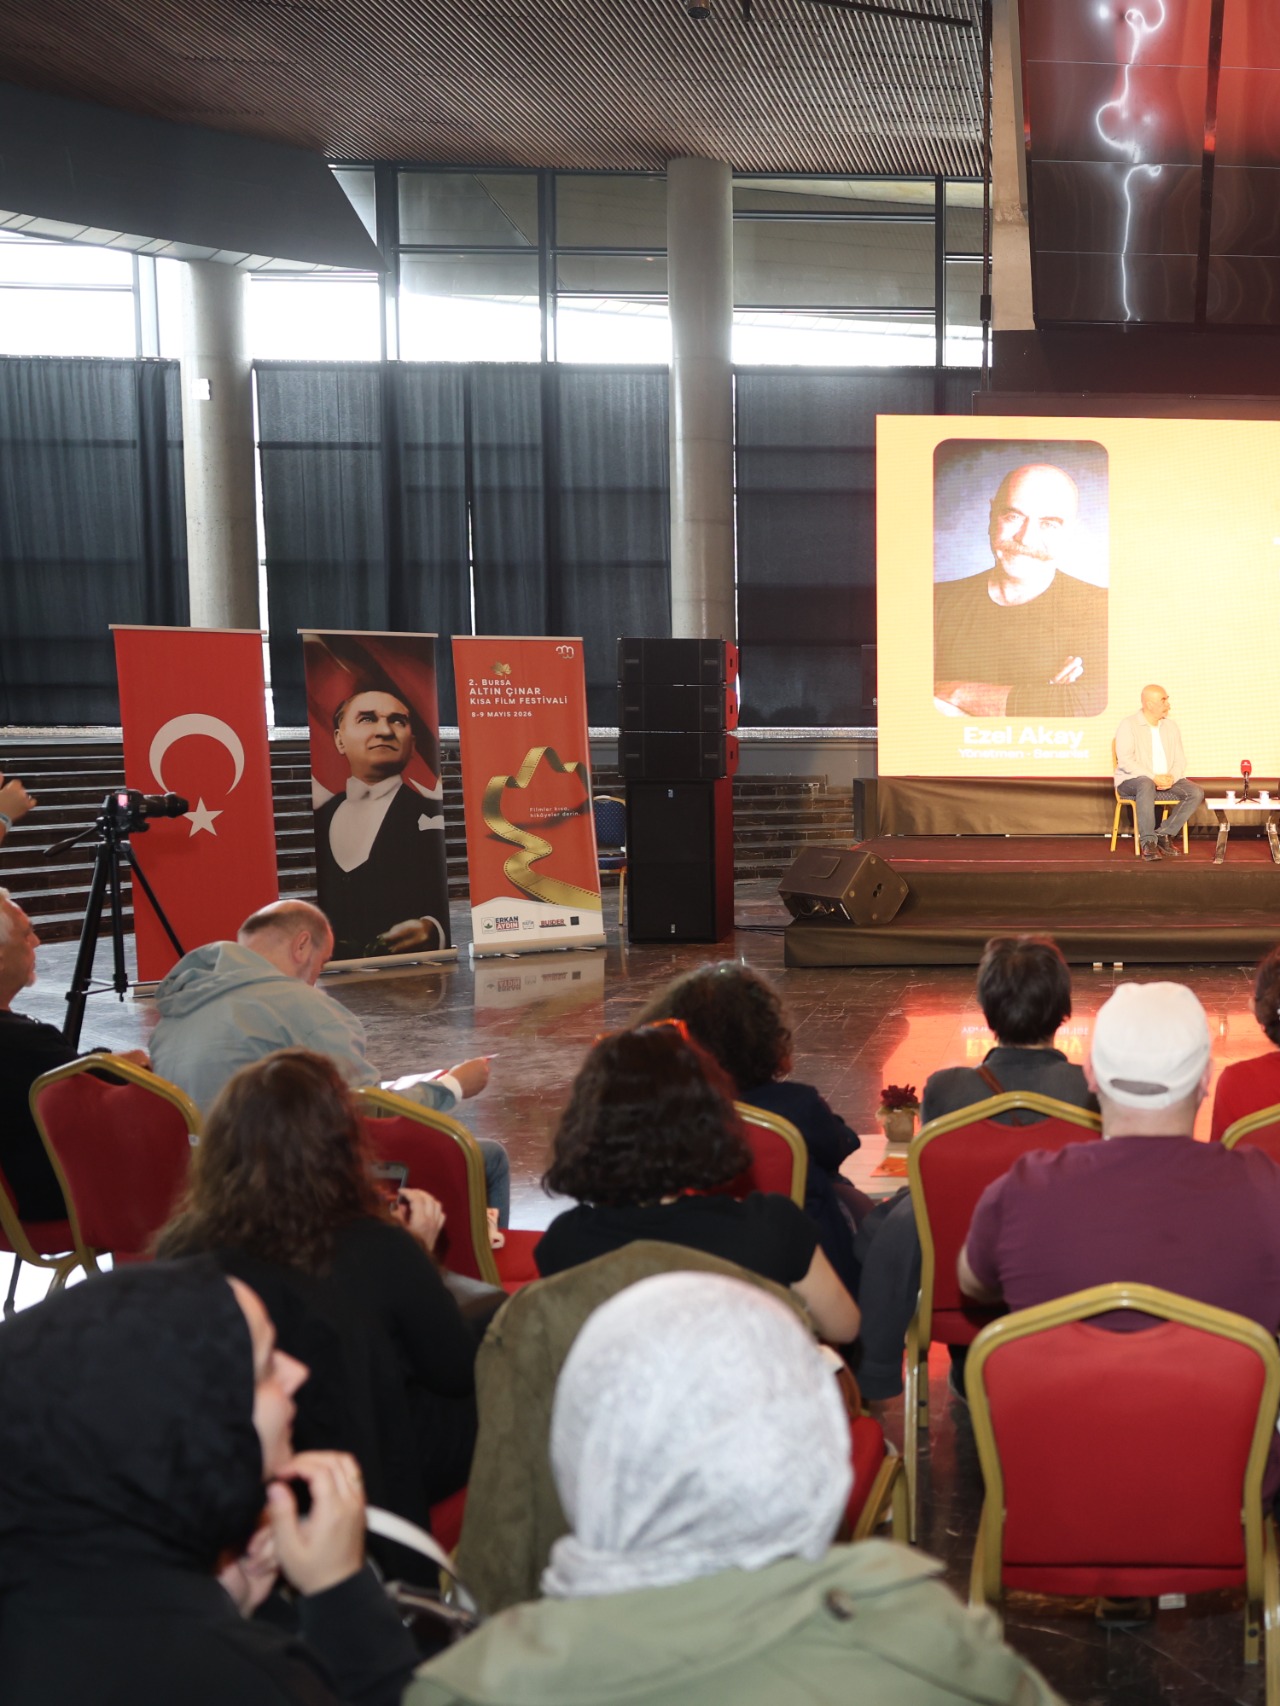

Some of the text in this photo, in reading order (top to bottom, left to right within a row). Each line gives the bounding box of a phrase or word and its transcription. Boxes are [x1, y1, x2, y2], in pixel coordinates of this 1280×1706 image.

[468, 678, 512, 686] 2. BURSA
[469, 687, 541, 697] ALTIN ÇINAR
[494, 697, 516, 705] FİLM
[519, 696, 568, 705] FESTİVALİ
[963, 725, 1084, 749] Ezel Akay
[496, 922, 520, 930] AYDIN
